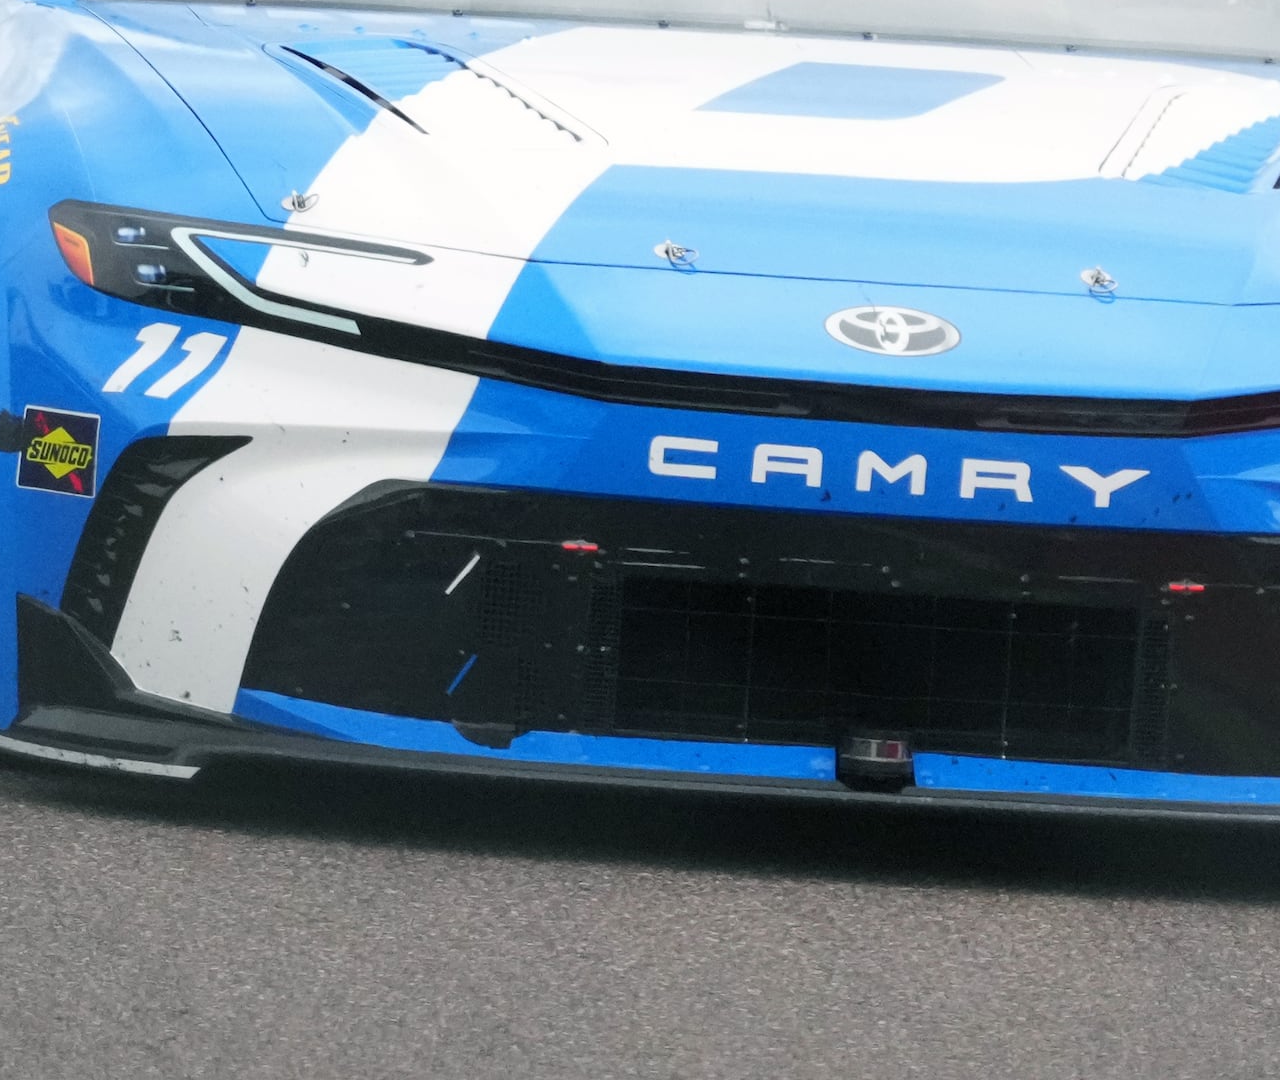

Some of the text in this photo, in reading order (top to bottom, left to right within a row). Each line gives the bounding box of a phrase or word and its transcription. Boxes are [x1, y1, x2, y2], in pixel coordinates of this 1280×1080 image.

[102, 322, 228, 399] 11
[29, 440, 91, 467] SUNOCO
[648, 435, 1150, 507] CAMRY
